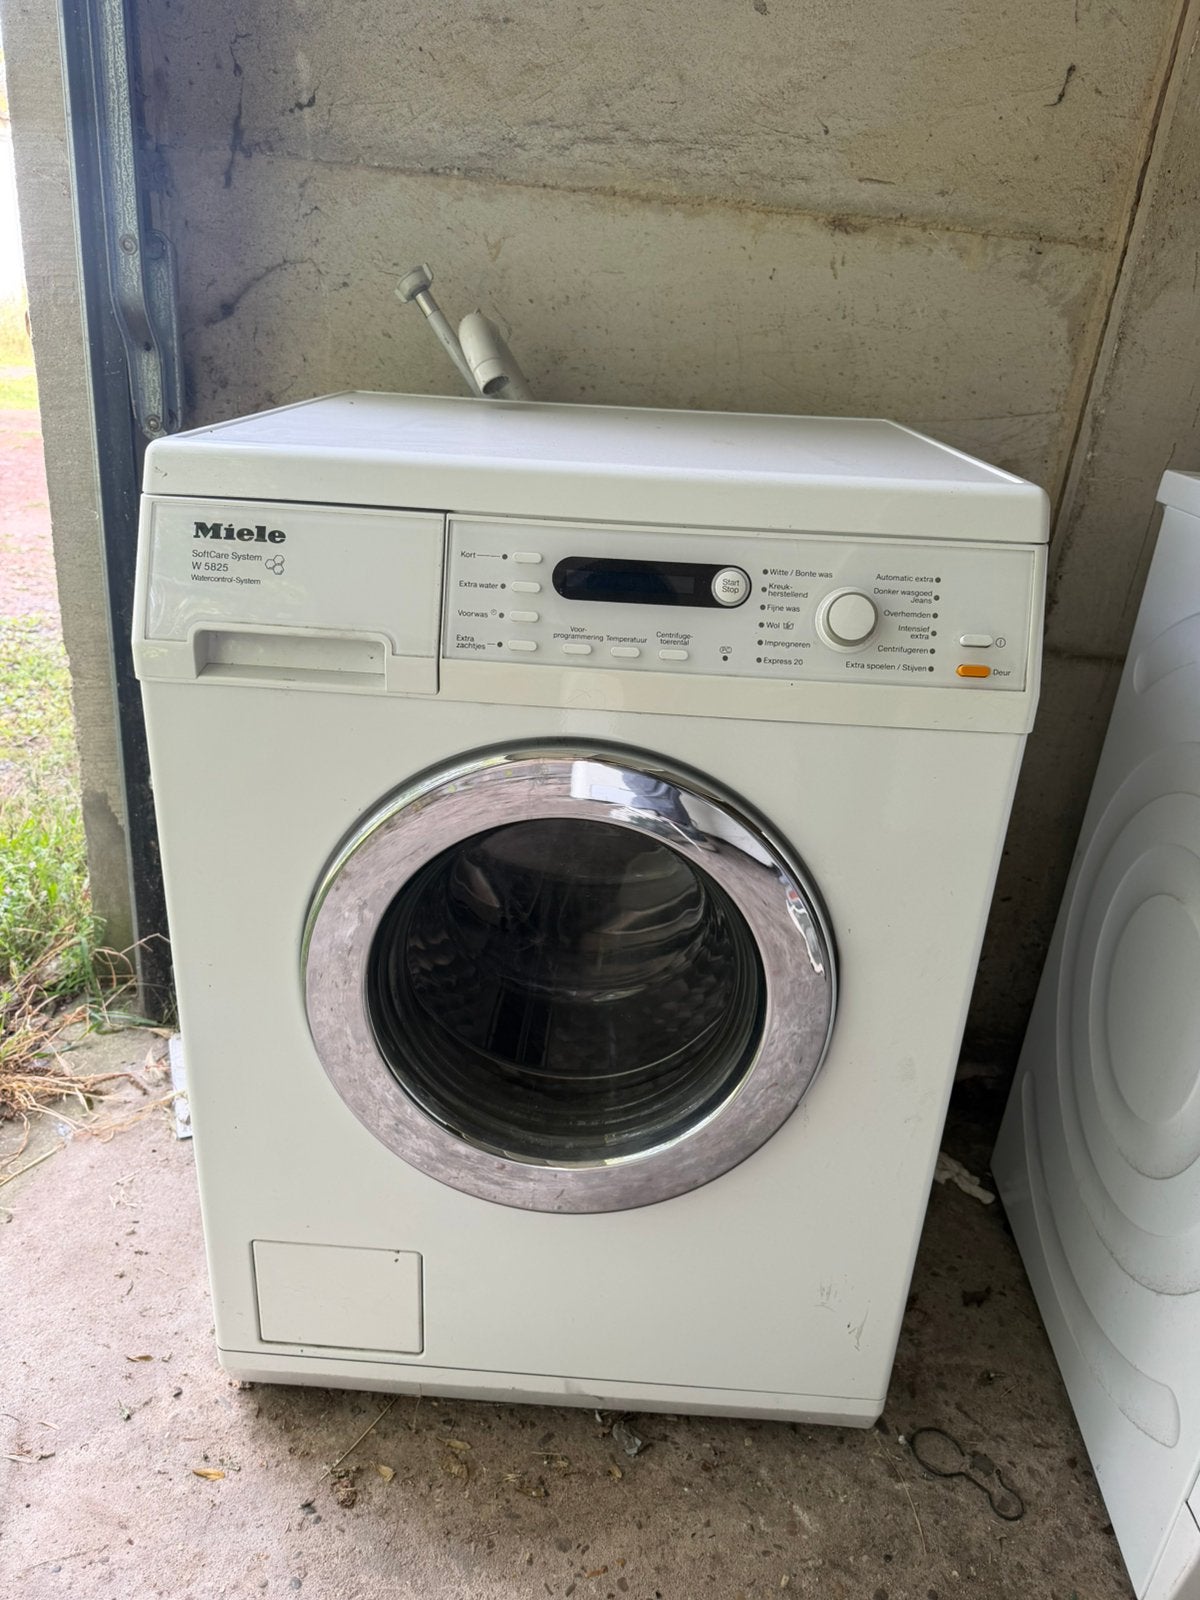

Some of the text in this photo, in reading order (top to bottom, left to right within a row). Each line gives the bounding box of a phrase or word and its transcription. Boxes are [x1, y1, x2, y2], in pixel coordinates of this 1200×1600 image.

[194, 522, 286, 543] Miele
[192, 549, 262, 562] SoftCare System
[460, 551, 476, 559] Kort
[192, 562, 229, 572] W 5825
[769, 568, 789, 576] Witte
[191, 574, 261, 585] Watercontrol-System
[876, 573, 914, 582] Automatic
[459, 580, 478, 588] Extra
[722, 578, 740, 587] Start
[721, 586, 740, 594] Stop
[768, 590, 808, 599] herstellend
[874, 588, 933, 598] Donker wasgoed
[767, 604, 784, 612] Fijne
[457, 610, 488, 618] Voorwas
[884, 609, 931, 619] Overhemden
[898, 625, 930, 633] Intensief
[456, 634, 474, 642] Extra
[553, 632, 604, 642] programmering
[606, 635, 648, 644] Temperatuur
[656, 631, 693, 641] Centrifuge-
[456, 641, 486, 651] zachtjes
[660, 638, 690, 646] toerental
[765, 640, 811, 648] Impregneren
[878, 645, 929, 655] Centrifugeren
[763, 657, 792, 666] Express
[846, 661, 865, 669] Extra
[867, 663, 896, 671] spoelen
[902, 664, 927, 673] Stijven
[993, 669, 1011, 677] Deur
